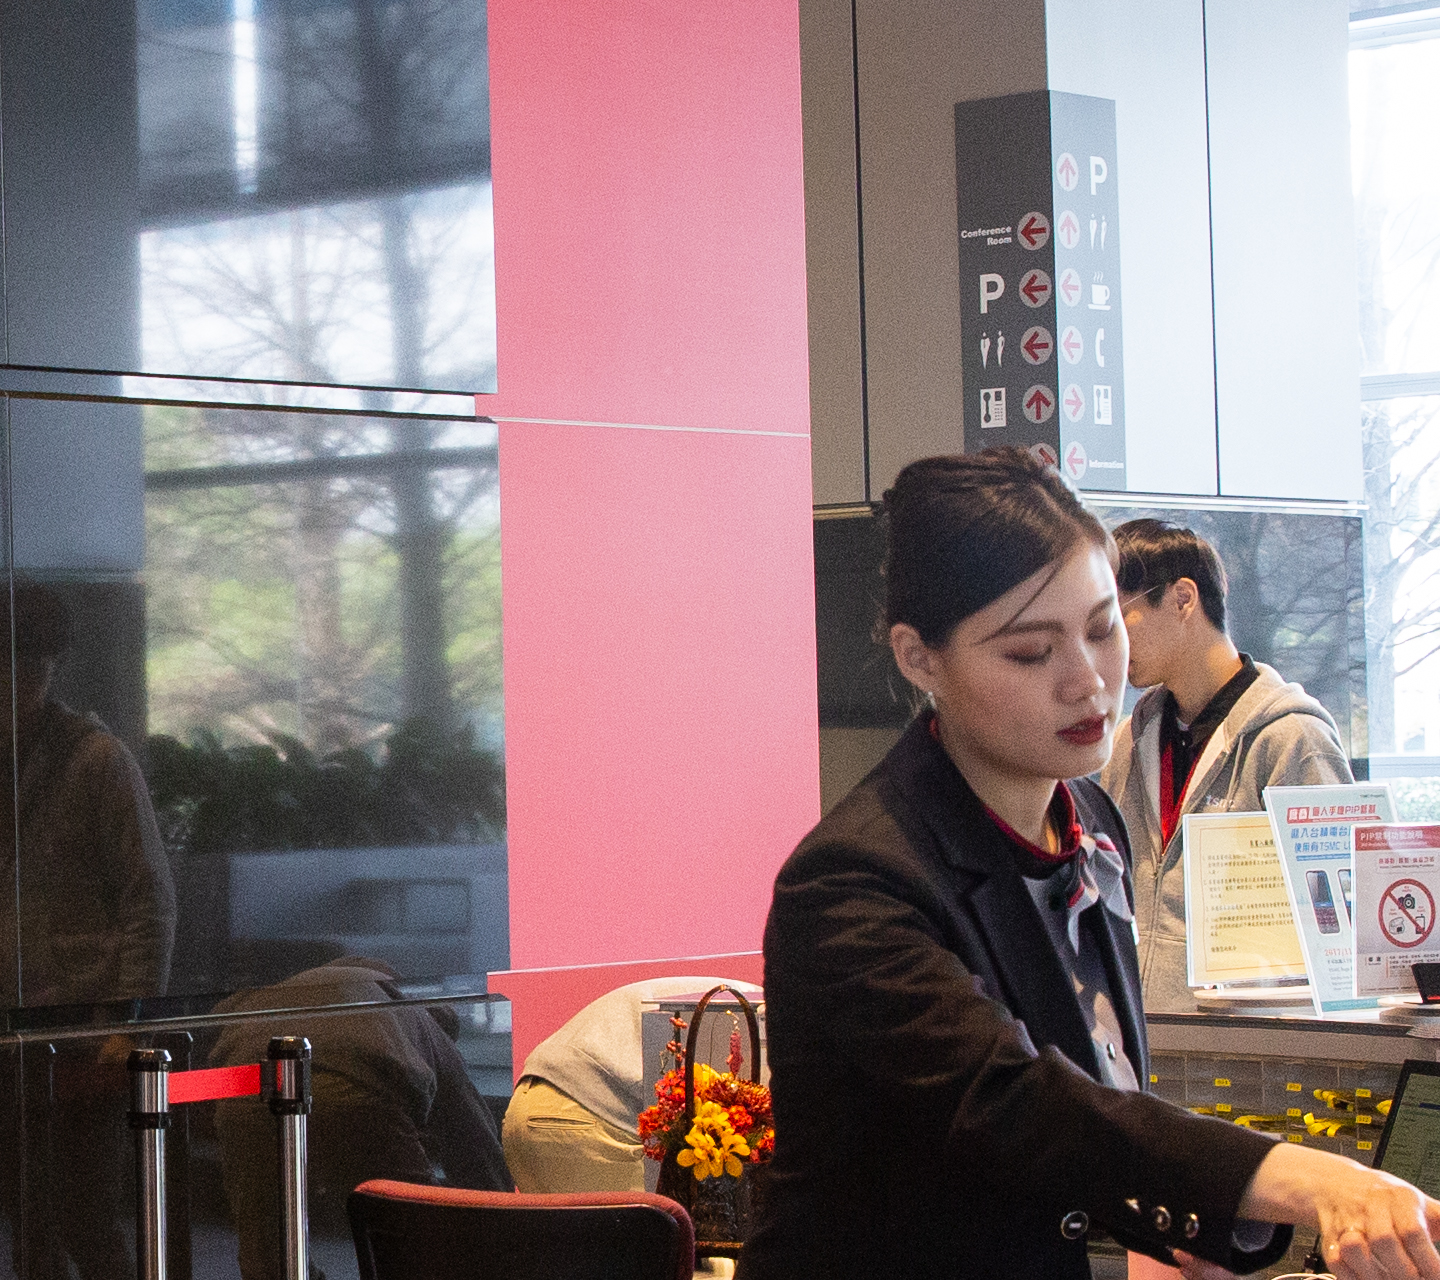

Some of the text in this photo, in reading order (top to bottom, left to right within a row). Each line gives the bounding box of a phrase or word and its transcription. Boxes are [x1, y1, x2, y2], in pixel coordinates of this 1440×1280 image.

[1089, 155, 1108, 196] P
[961, 226, 1012, 238] Conference
[987, 237, 1012, 246] Room
[980, 273, 1005, 314] P
[1089, 459, 1124, 468] Information
